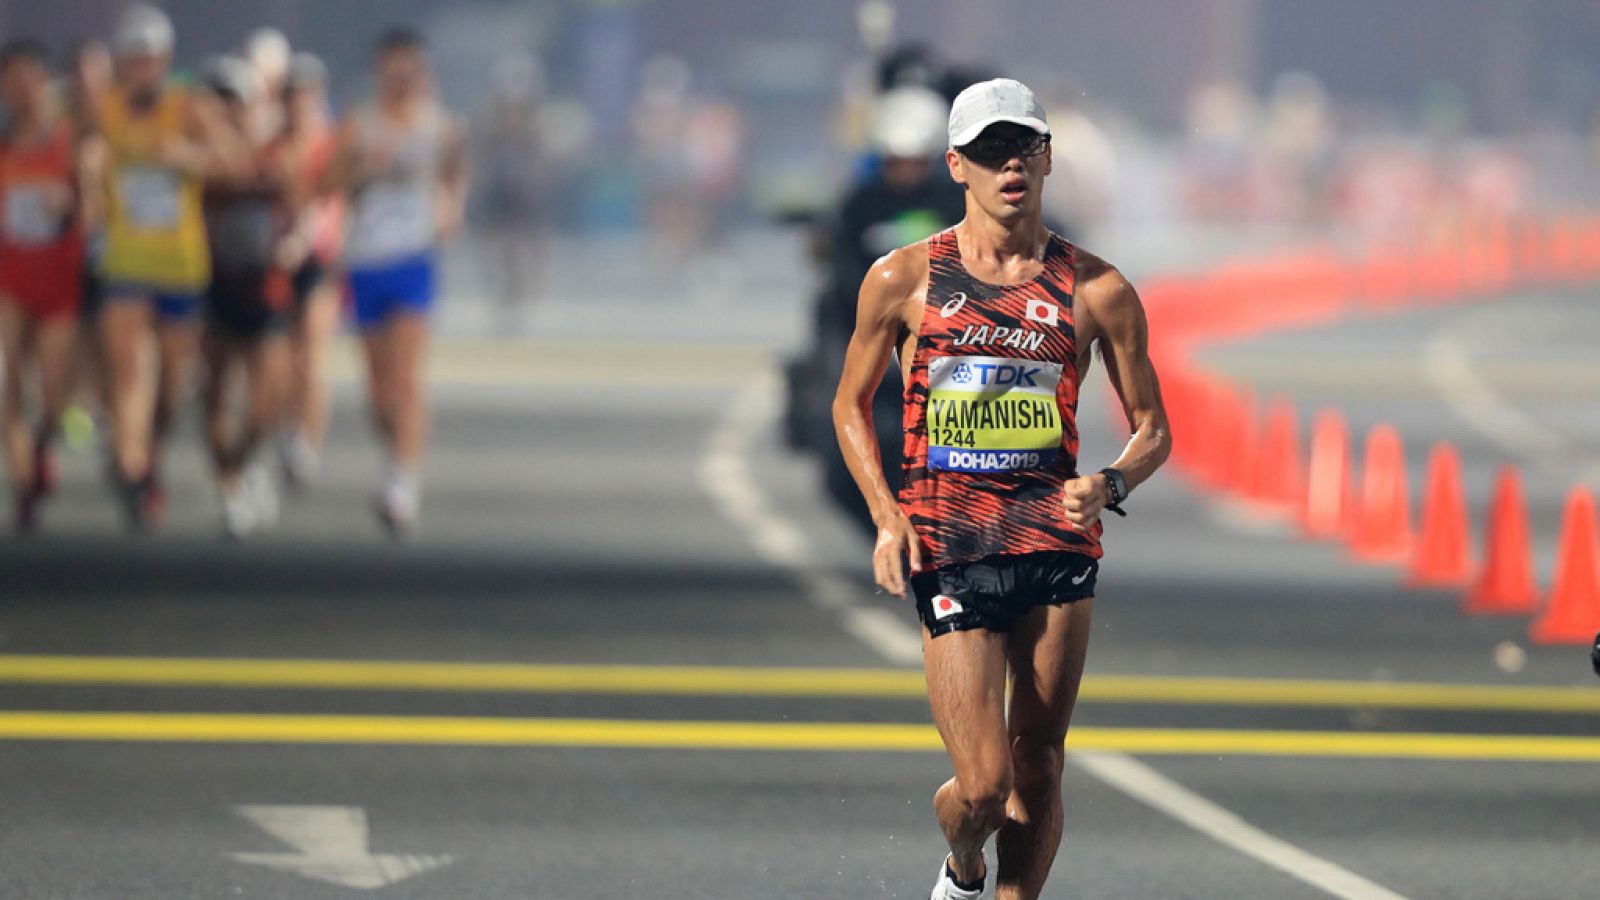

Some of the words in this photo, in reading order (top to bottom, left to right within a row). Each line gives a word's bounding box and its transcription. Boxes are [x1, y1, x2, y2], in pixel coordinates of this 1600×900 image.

[953, 324, 1045, 350] JAPAN
[973, 363, 1042, 387] TDK
[931, 399, 1054, 429] YAMANISHI
[931, 428, 976, 447] 1244
[948, 451, 1040, 469] DOHA2019
